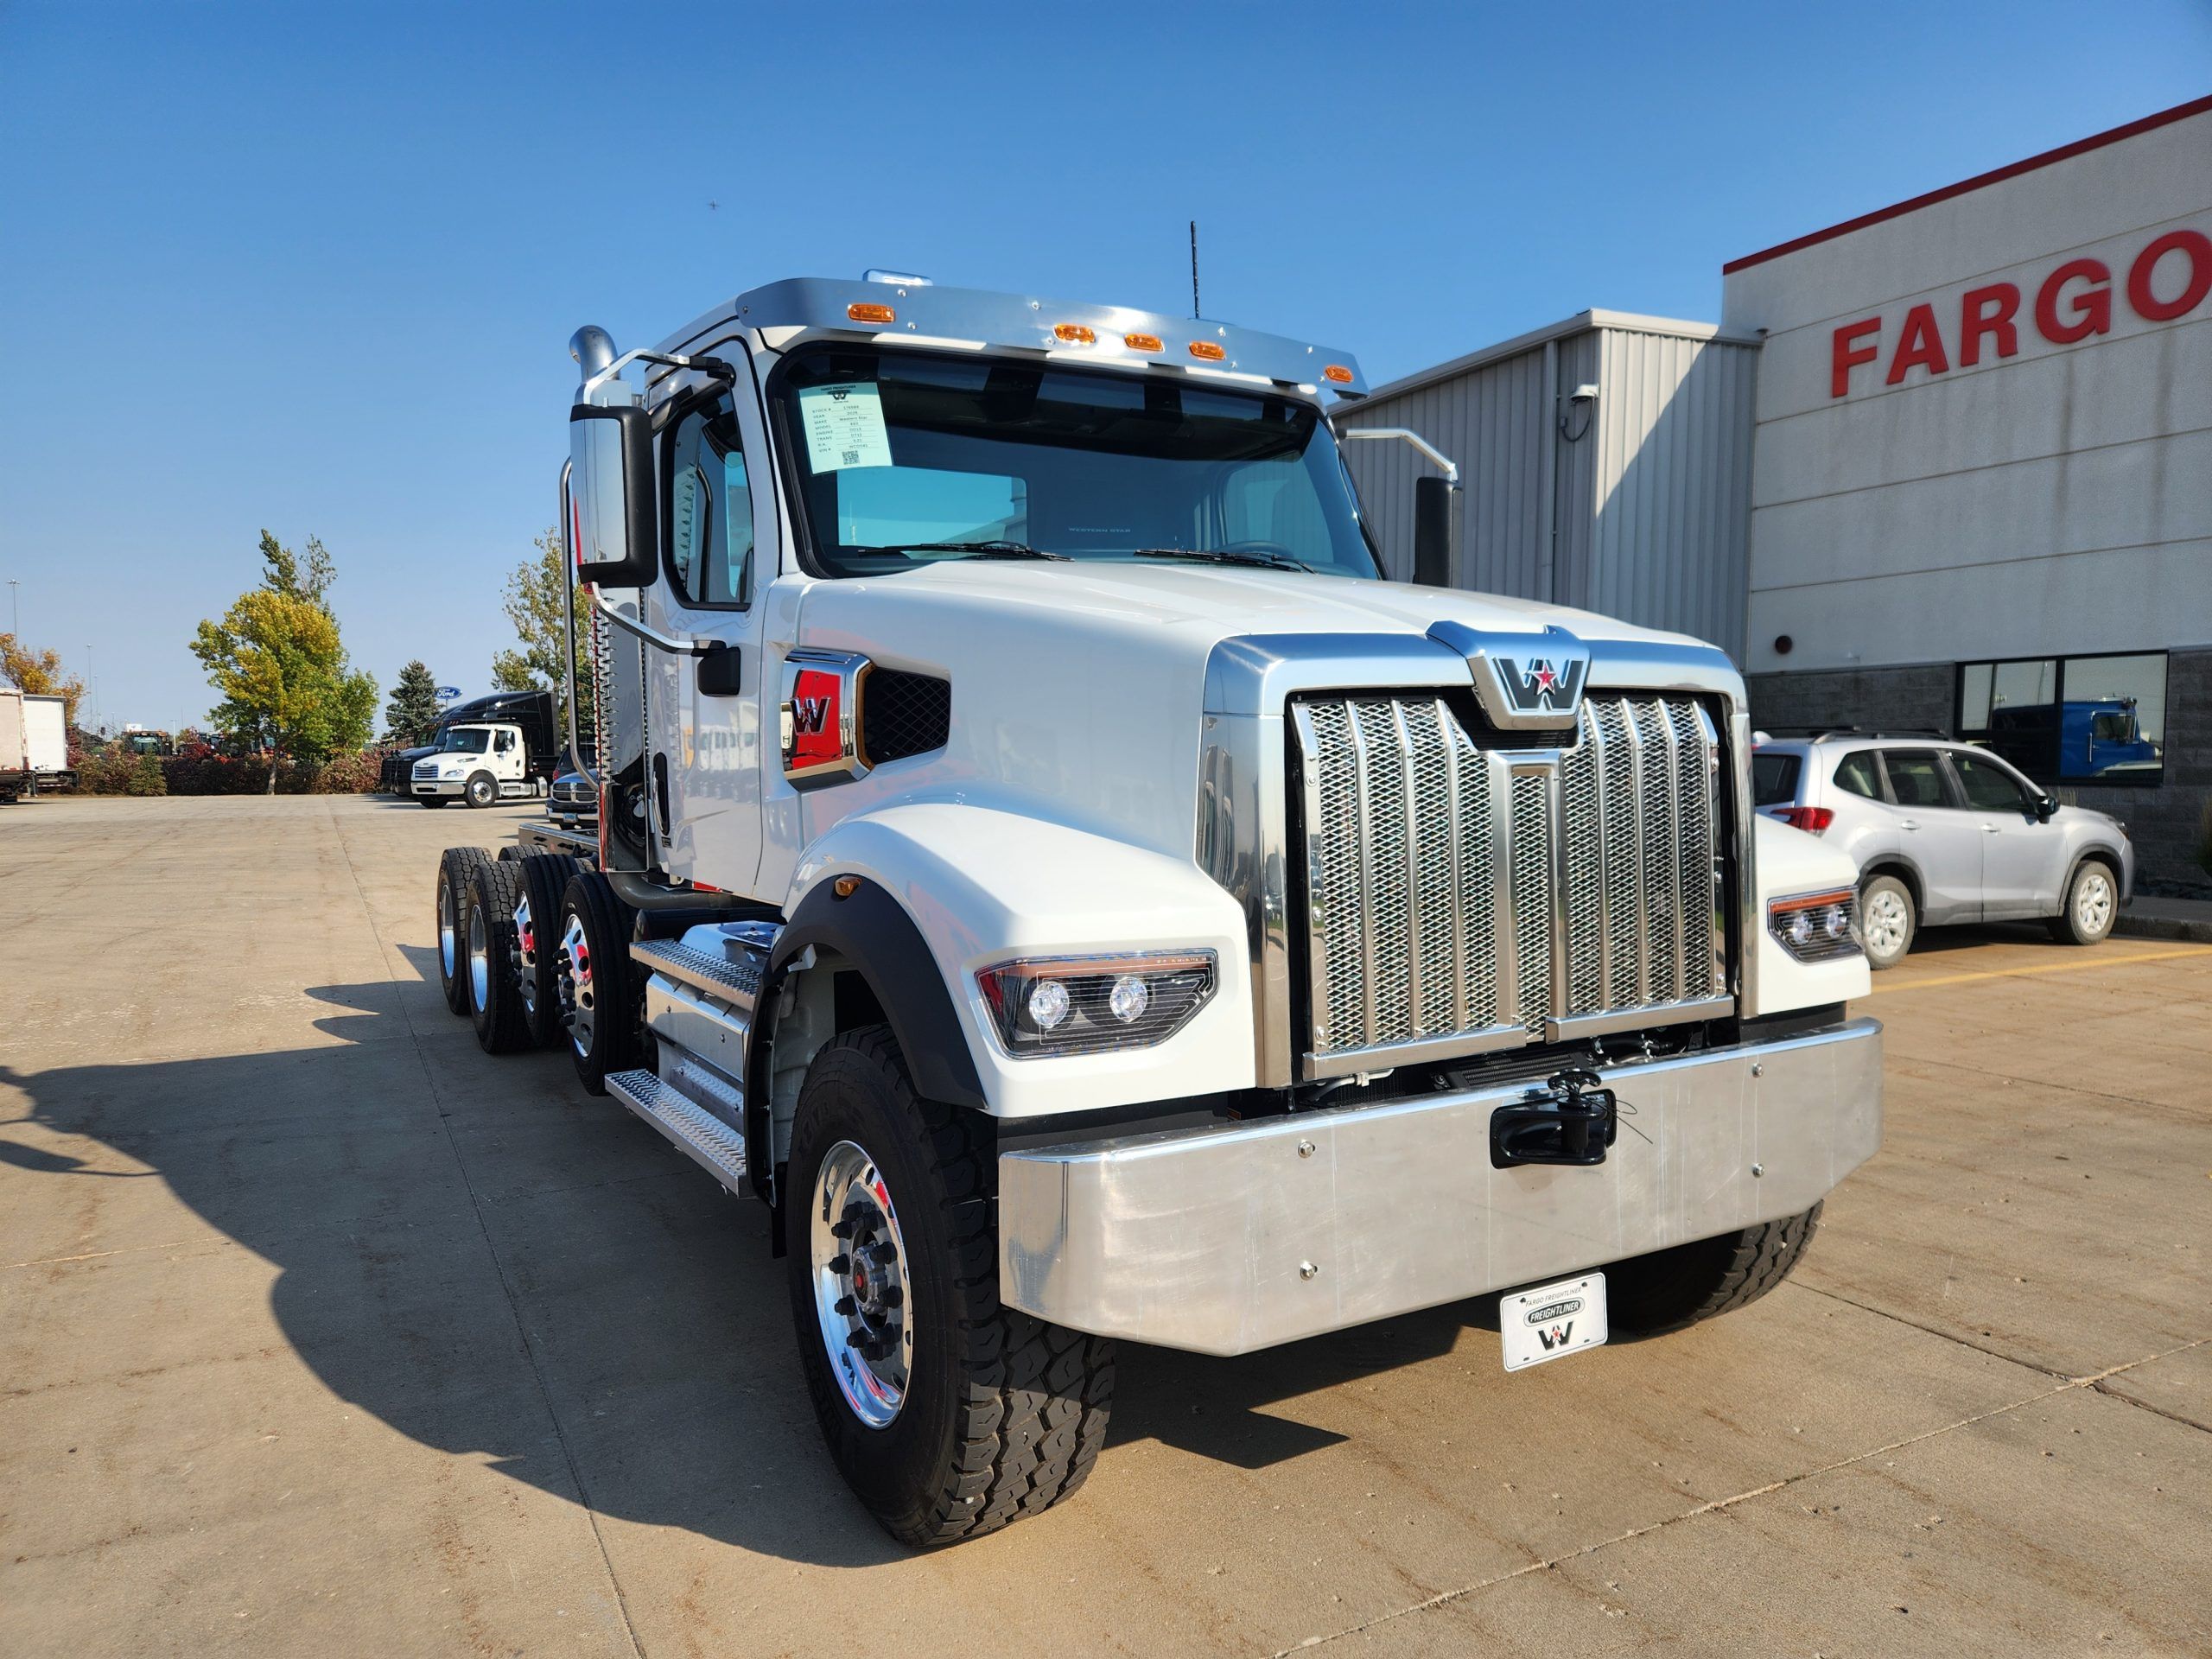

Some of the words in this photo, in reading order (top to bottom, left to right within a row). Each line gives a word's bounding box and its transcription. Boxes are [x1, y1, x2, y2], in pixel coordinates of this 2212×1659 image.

[1832, 229, 2212, 398] FARGO
[437, 688, 455, 697] Ford
[1525, 1297, 1544, 1307] FARGO
[1544, 1287, 1582, 1302] FREIGHTLINER
[1529, 1301, 1580, 1323] FREIGHTLINER
